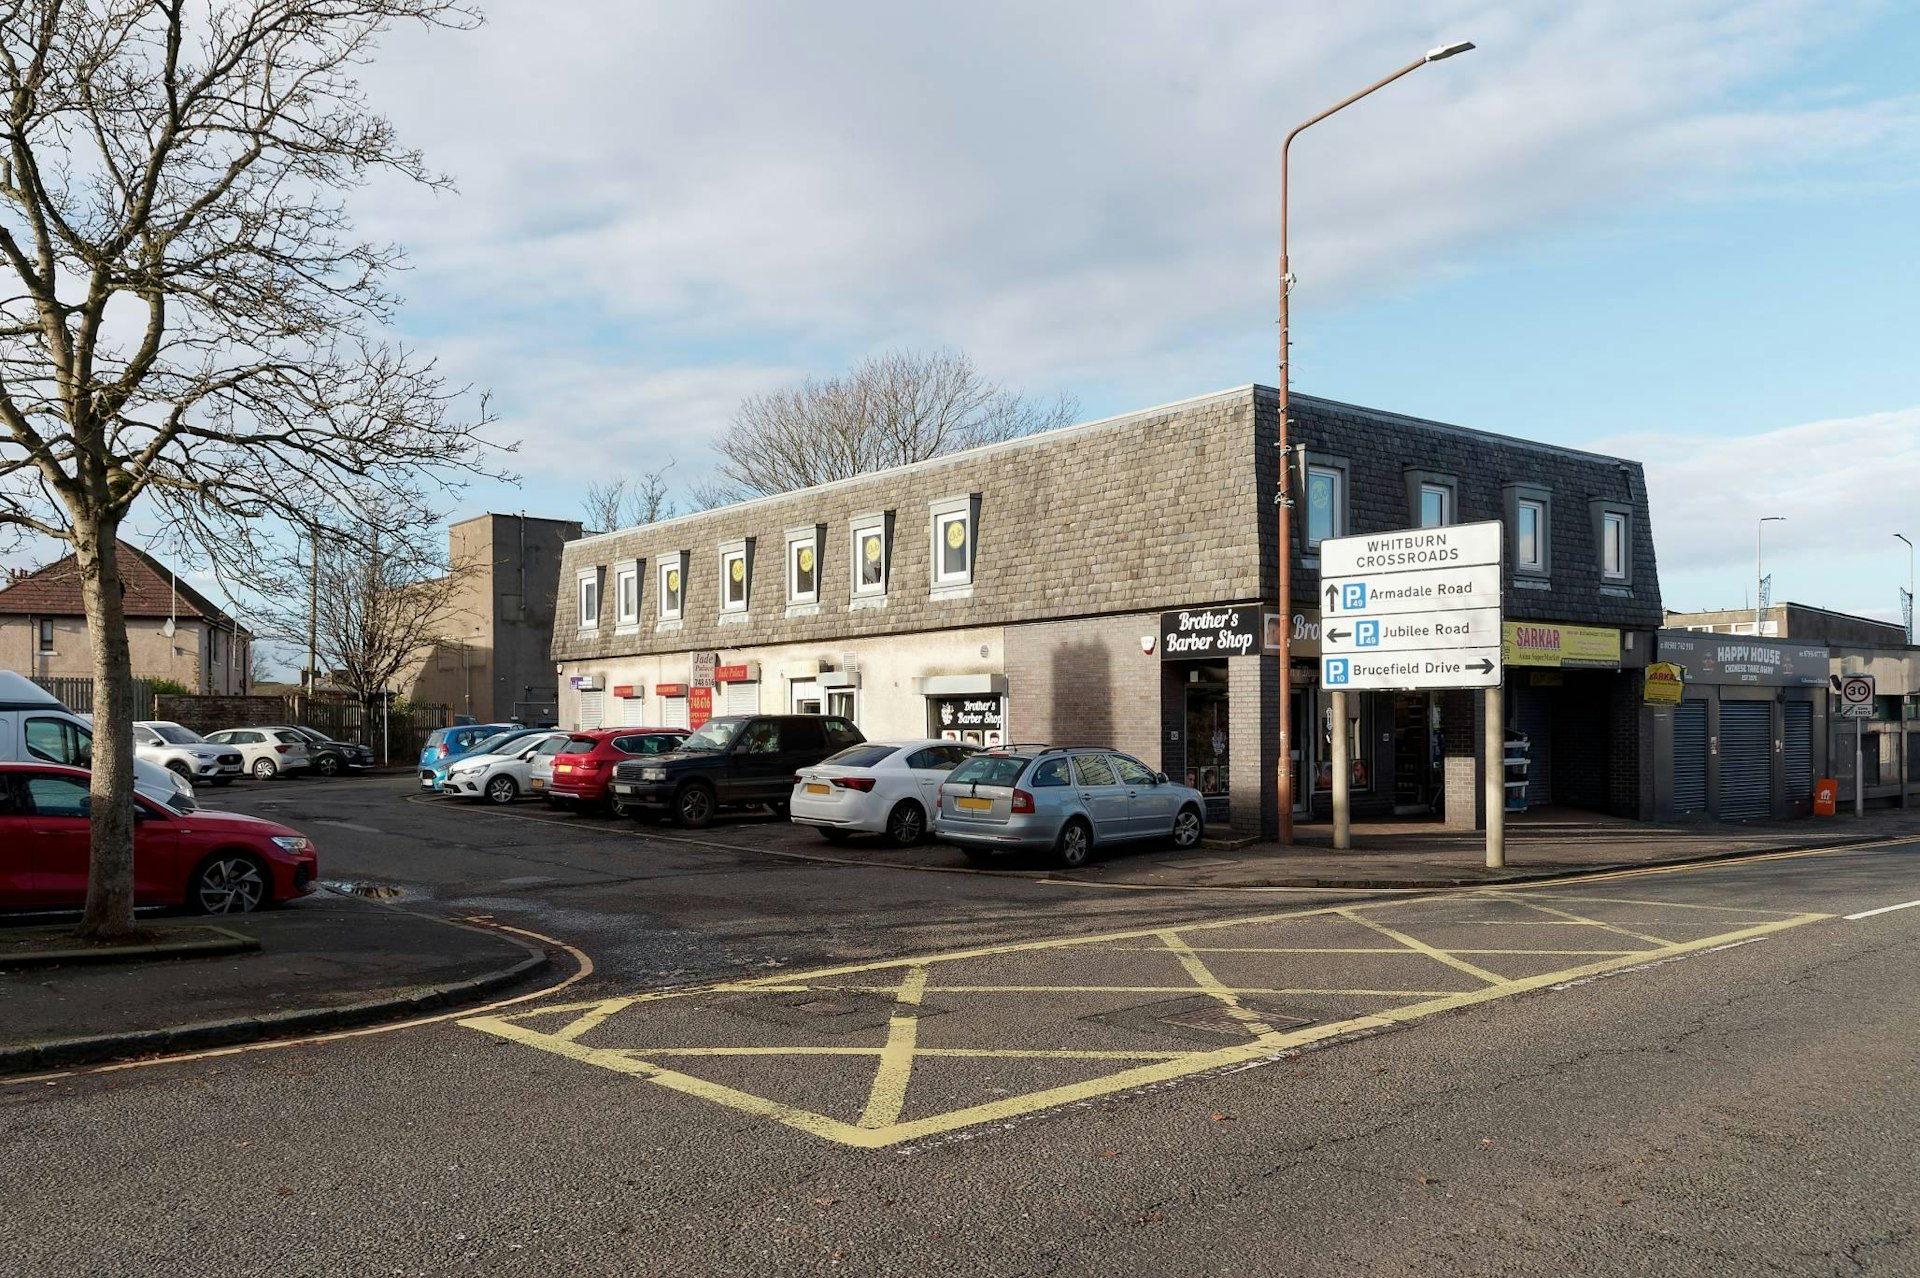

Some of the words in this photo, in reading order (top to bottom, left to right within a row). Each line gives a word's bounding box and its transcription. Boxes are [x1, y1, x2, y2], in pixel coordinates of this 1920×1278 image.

[1367, 534, 1447, 552] WHITBURN
[1356, 548, 1459, 568] CROSSROADS
[1346, 586, 1361, 607] P
[1369, 586, 1432, 600] Armadale
[1438, 582, 1473, 595] Road
[1179, 609, 1239, 632] Brother's
[1359, 624, 1374, 645] P
[1383, 626, 1429, 638] Jubilee
[1435, 622, 1470, 635] Road
[1516, 626, 1560, 649] SARKAR
[1166, 633, 1213, 652] Barber
[1217, 629, 1253, 655] Shop
[694, 653, 713, 664] Jade
[1717, 646, 1749, 662] HAPPY
[1750, 647, 1781, 665] HOUSE
[1329, 662, 1343, 683] P
[1353, 662, 1419, 676] Brucefield
[1425, 662, 1460, 674] Drive
[1725, 664, 1747, 673] CHINESE
[1848, 686, 1867, 695] 30
[963, 700, 996, 711] Brother's
[957, 711, 983, 724] Barber
[984, 711, 1002, 728] Shop
